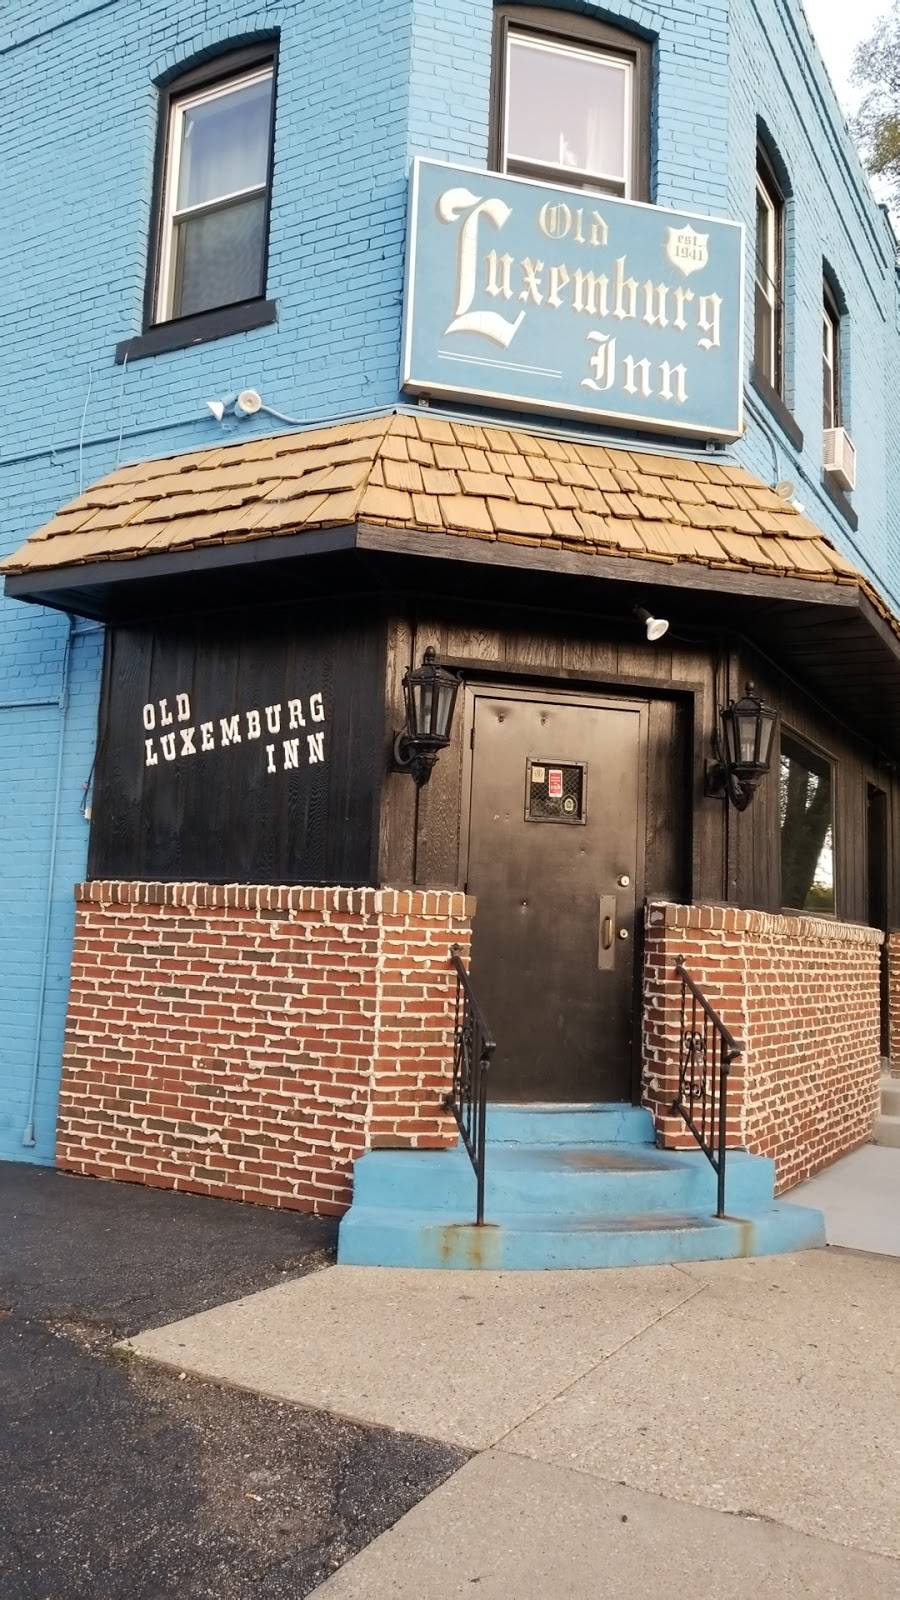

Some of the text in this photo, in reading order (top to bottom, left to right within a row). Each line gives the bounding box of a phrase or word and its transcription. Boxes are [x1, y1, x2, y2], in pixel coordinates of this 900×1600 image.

[538, 200, 609, 246] Old
[437, 187, 723, 350] Luxemburg
[581, 331, 689, 403] Inn
[142, 692, 191, 731] OLD
[144, 692, 326, 766] LUXEMBURG
[265, 731, 325, 774] INN
